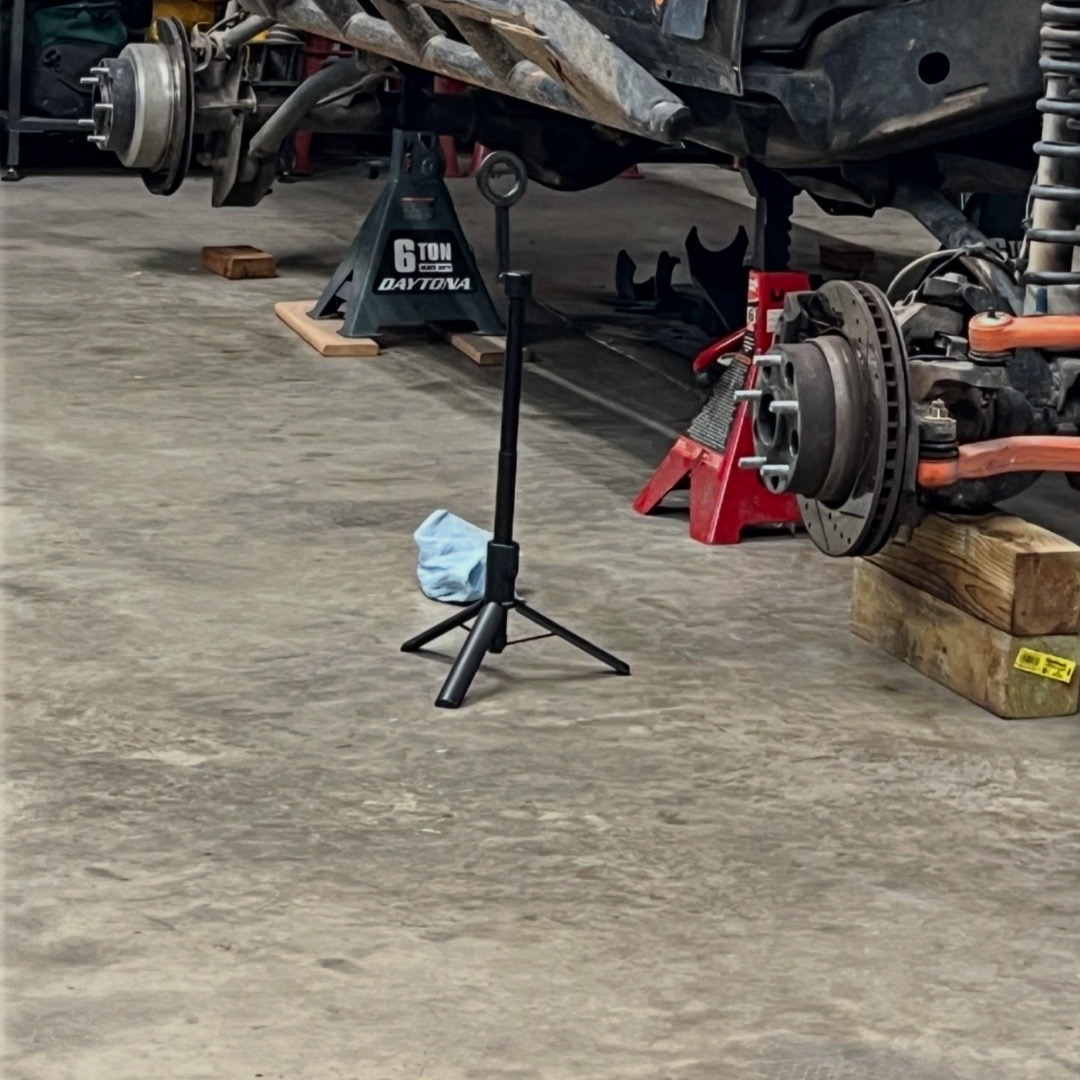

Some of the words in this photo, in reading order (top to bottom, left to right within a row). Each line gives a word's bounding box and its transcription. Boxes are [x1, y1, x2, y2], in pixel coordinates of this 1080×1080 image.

[394, 238, 416, 273] 6
[417, 242, 452, 261] TON
[378, 277, 471, 291] DAYTONA
